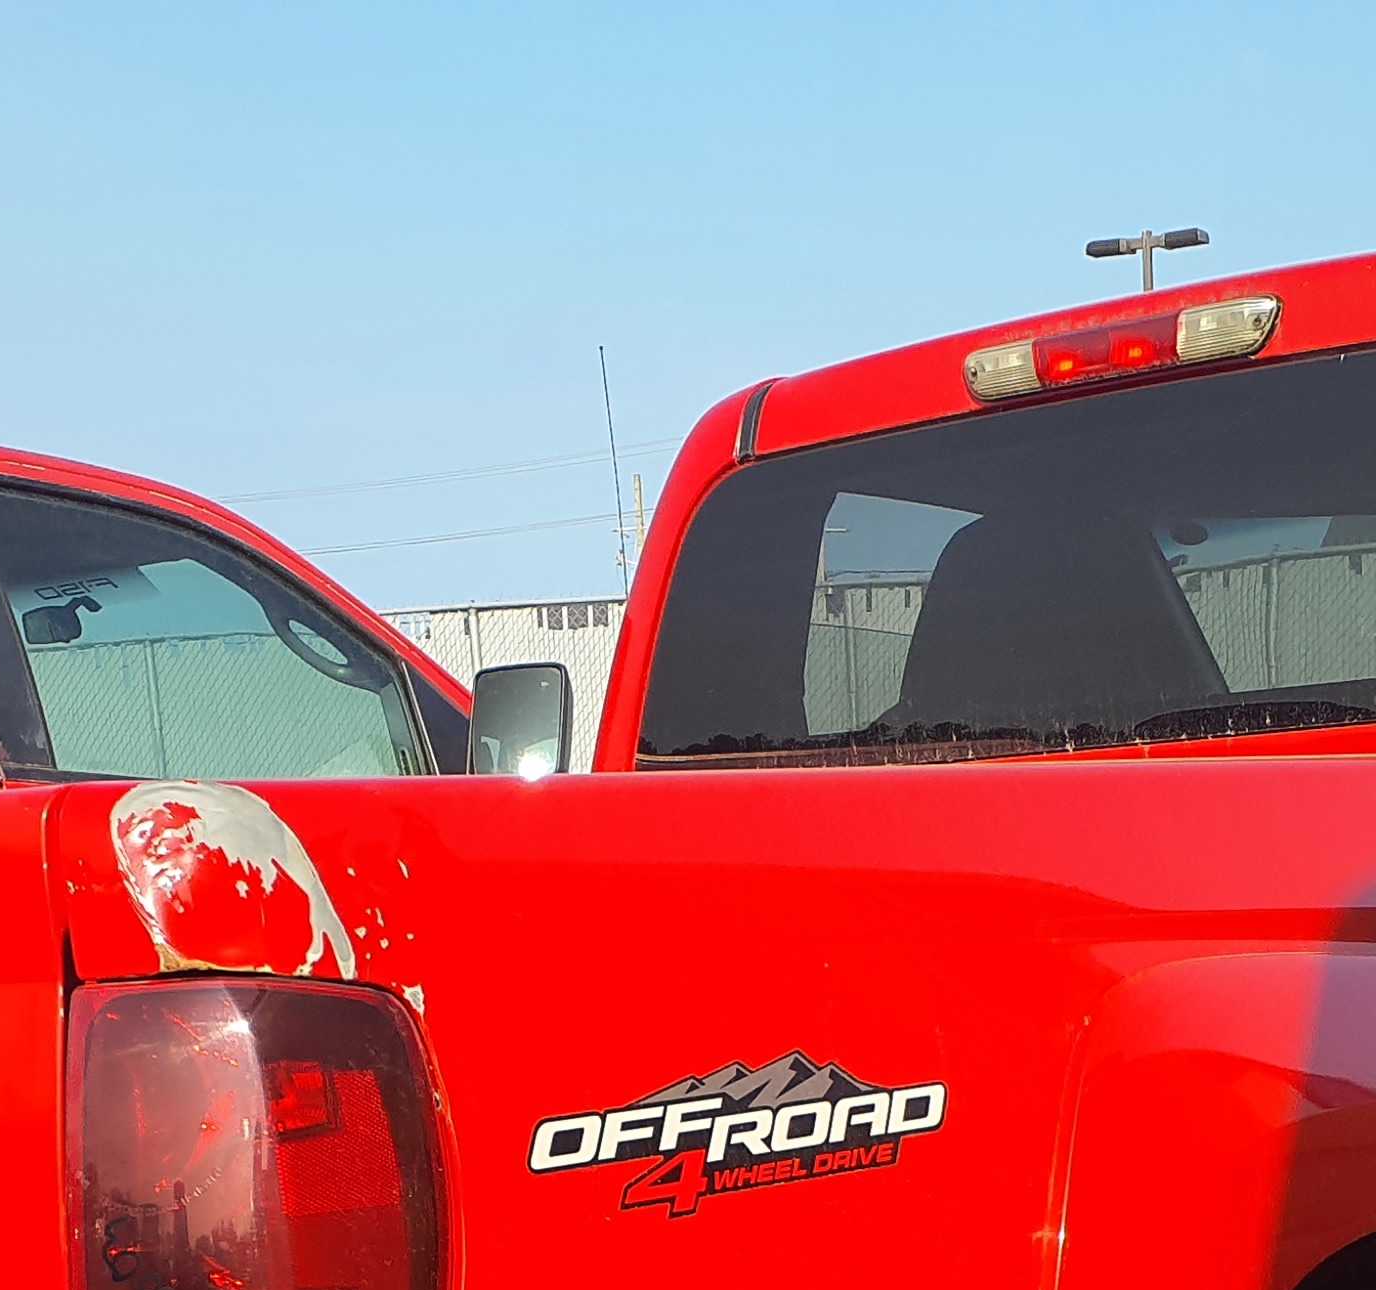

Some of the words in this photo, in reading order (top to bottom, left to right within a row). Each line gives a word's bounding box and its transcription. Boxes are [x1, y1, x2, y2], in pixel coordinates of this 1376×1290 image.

[623, 1149, 708, 1215] 4
[714, 1157, 808, 1190] WHEEL
[815, 1143, 894, 1172] DRIVE
